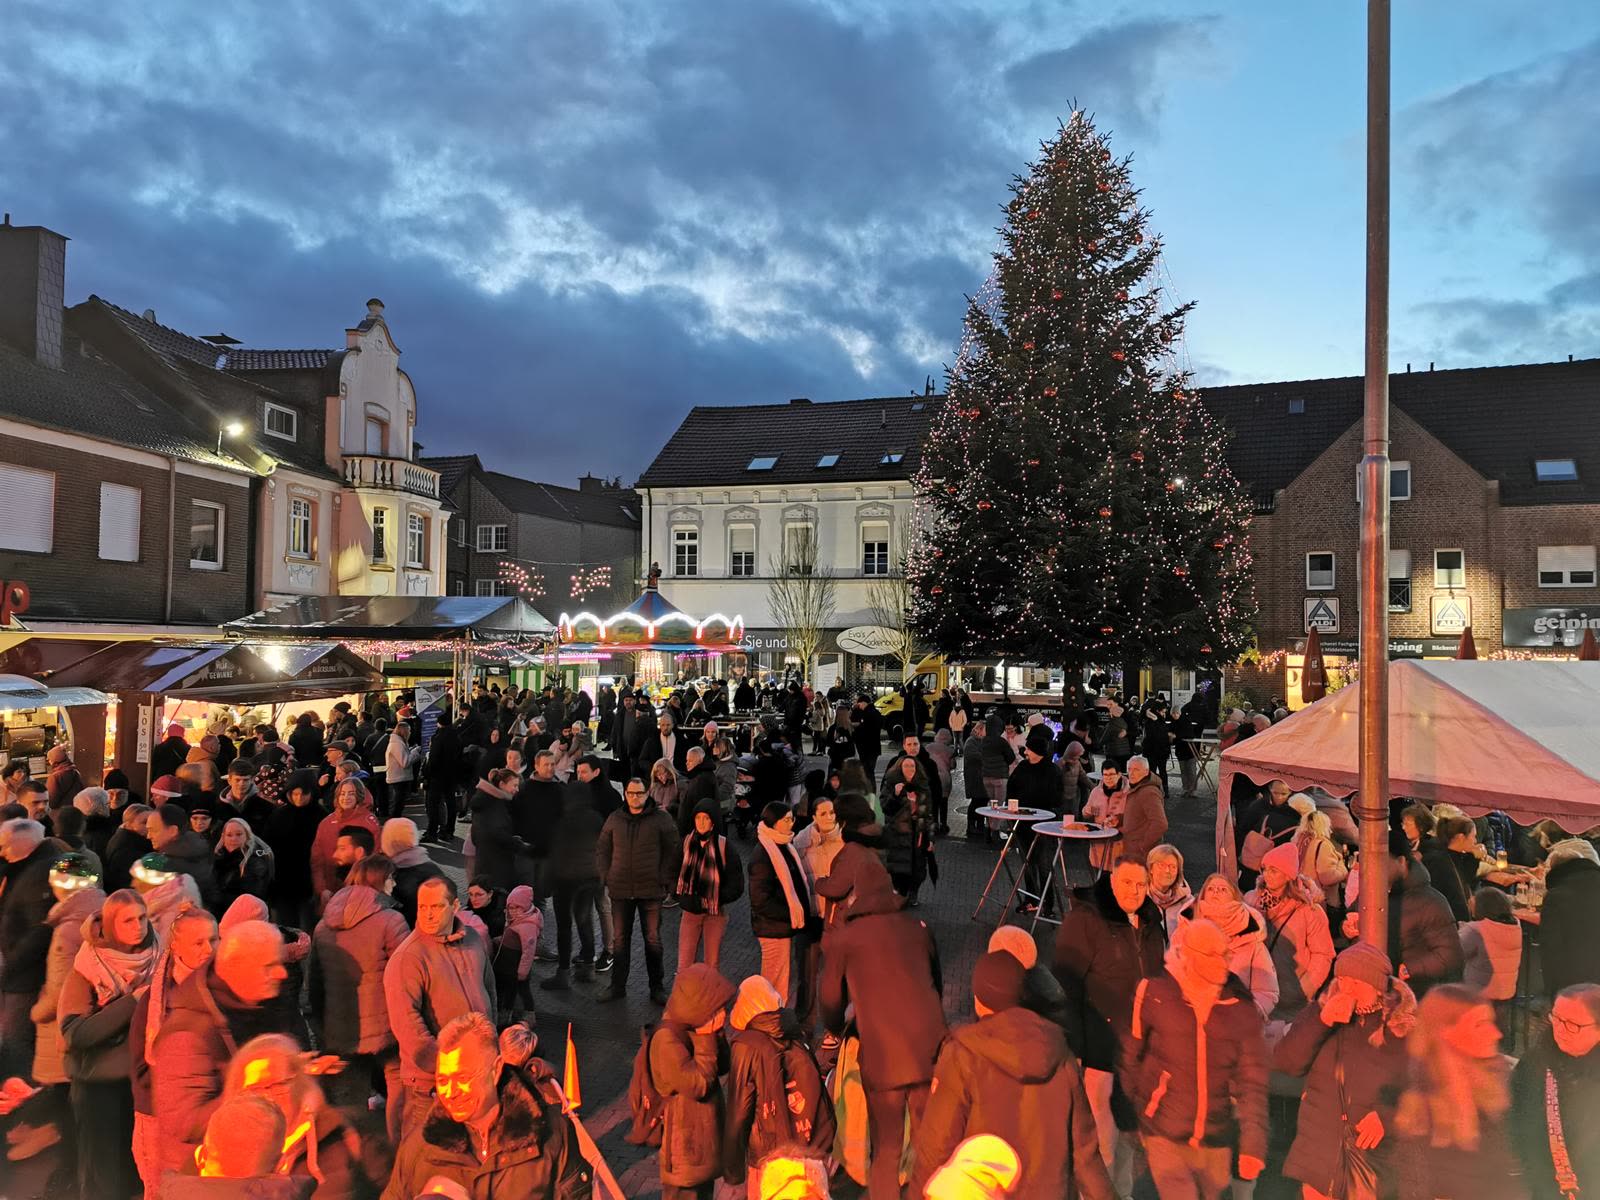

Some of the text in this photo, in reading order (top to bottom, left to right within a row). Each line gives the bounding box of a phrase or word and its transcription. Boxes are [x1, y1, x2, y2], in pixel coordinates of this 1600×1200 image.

[1533, 612, 1600, 634] geipin
[745, 635, 763, 648] Sie
[765, 635, 788, 648] und
[1388, 641, 1423, 653] eiping
